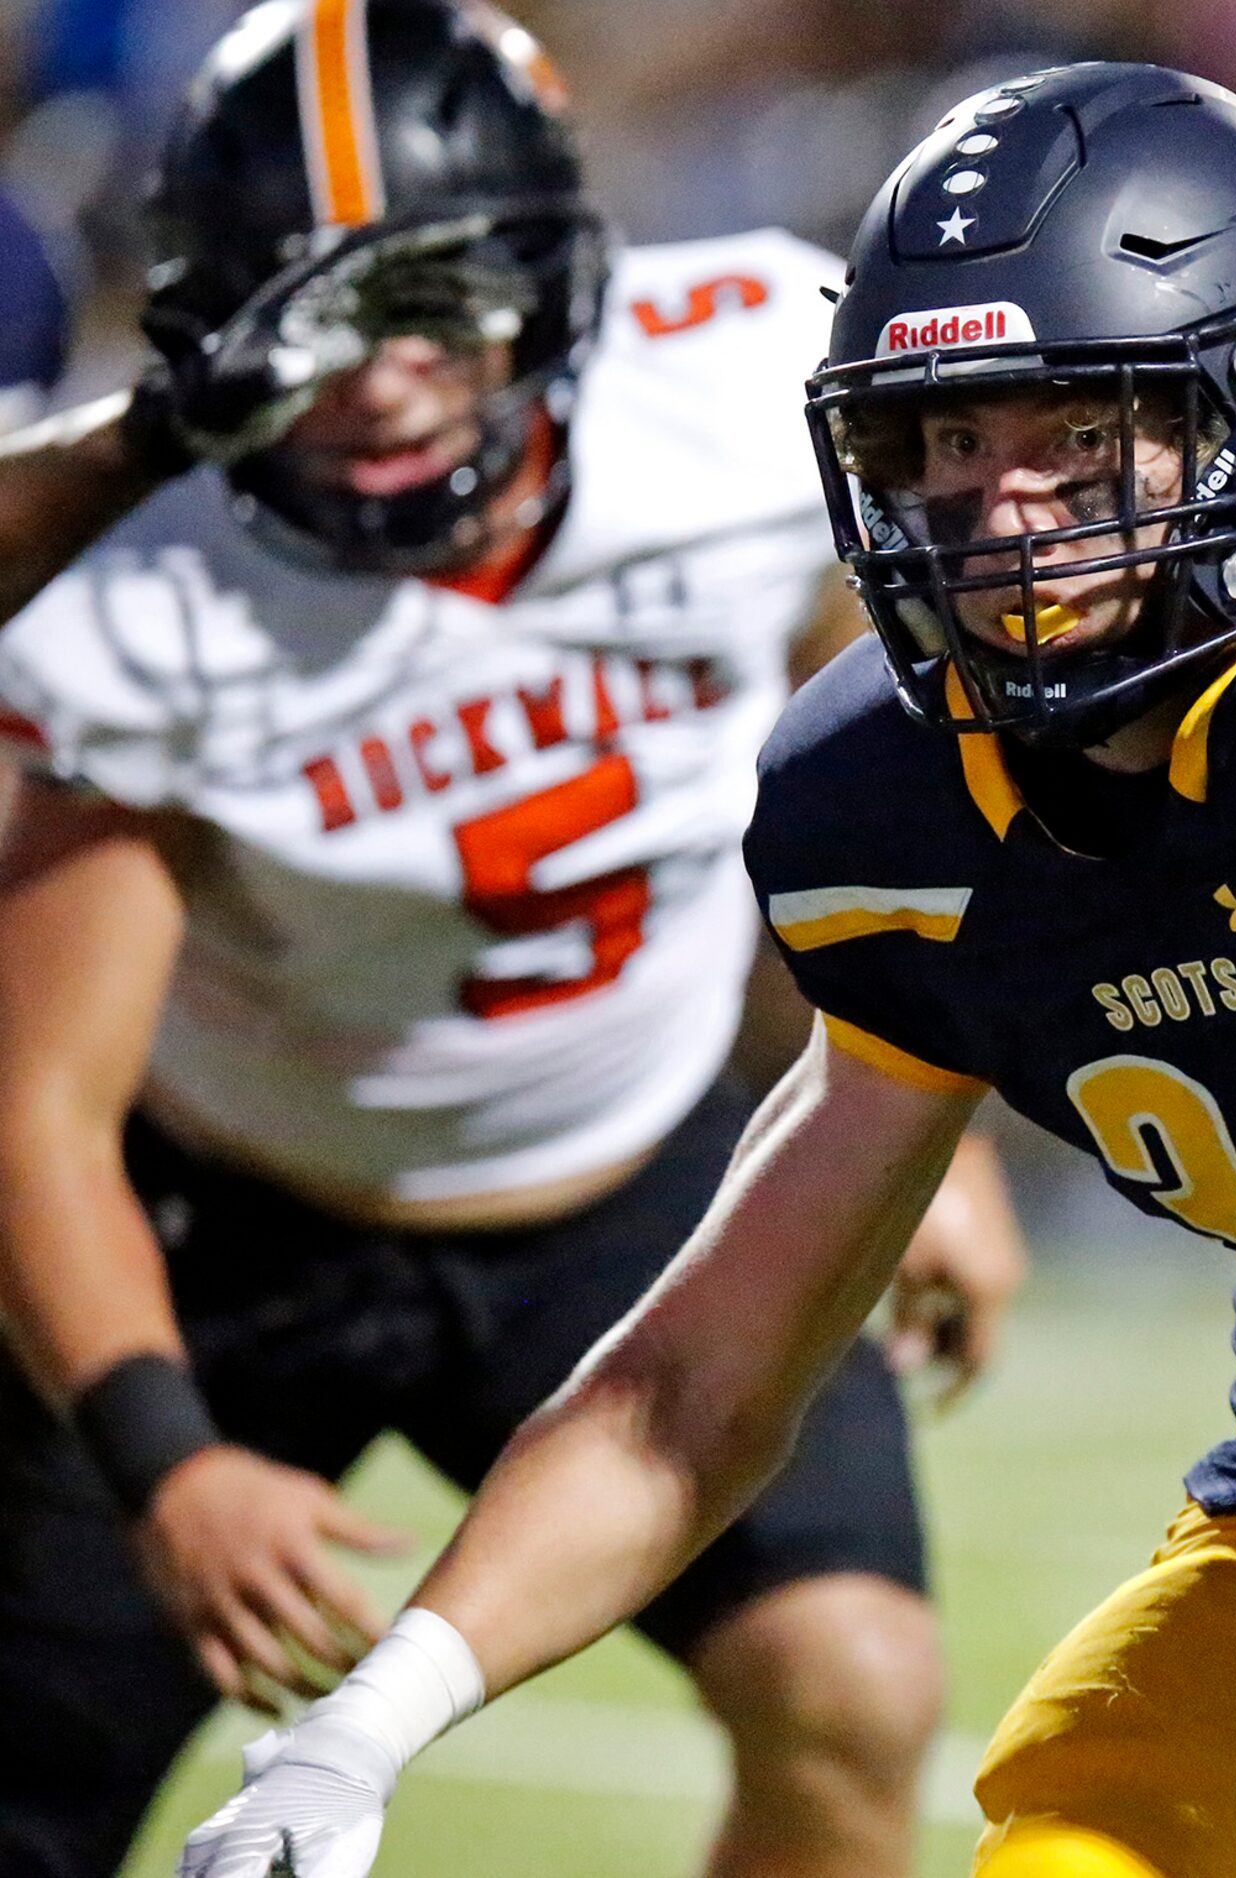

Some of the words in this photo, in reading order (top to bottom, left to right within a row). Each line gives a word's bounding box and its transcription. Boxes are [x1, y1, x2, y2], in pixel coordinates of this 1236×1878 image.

[631, 273, 769, 340] 5
[889, 310, 1006, 351] Riddell
[1196, 448, 1236, 500] dell
[860, 491, 909, 550] ddell
[1005, 681, 1066, 699] Ridell
[452, 752, 651, 1019] 5
